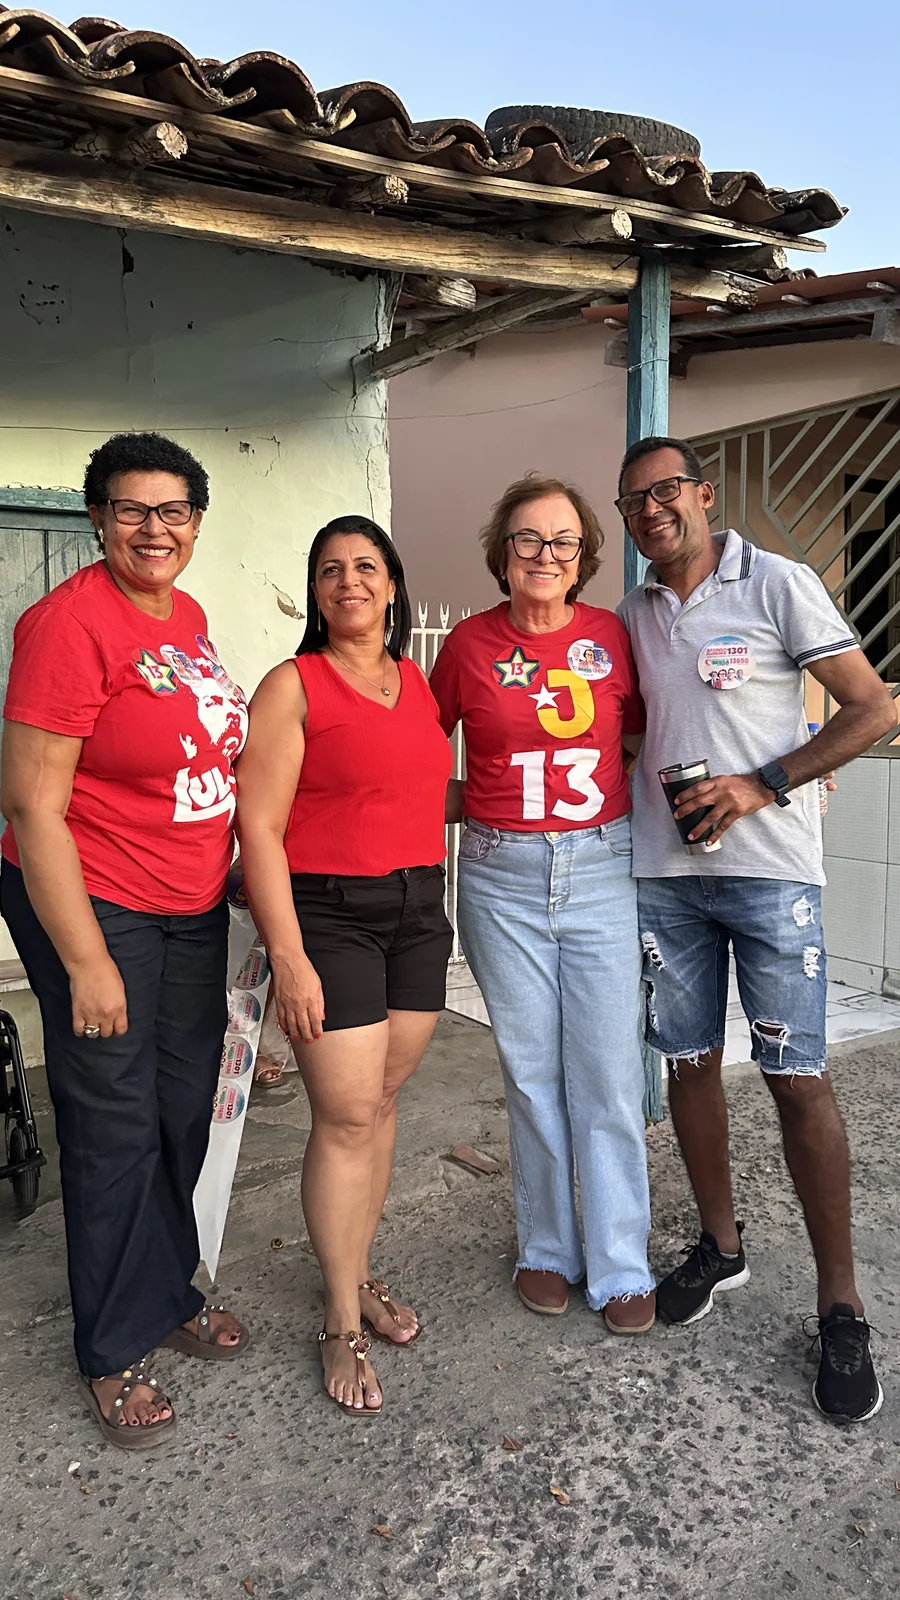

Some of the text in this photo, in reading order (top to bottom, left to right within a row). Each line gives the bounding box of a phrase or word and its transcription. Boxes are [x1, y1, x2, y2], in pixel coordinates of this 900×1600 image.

[146, 665, 163, 680] 13
[510, 662, 524, 676] 13
[537, 669, 595, 739] J
[510, 748, 605, 821] 13
[234, 1059, 242, 1075] 1301
[226, 1104, 234, 1119] 1301
